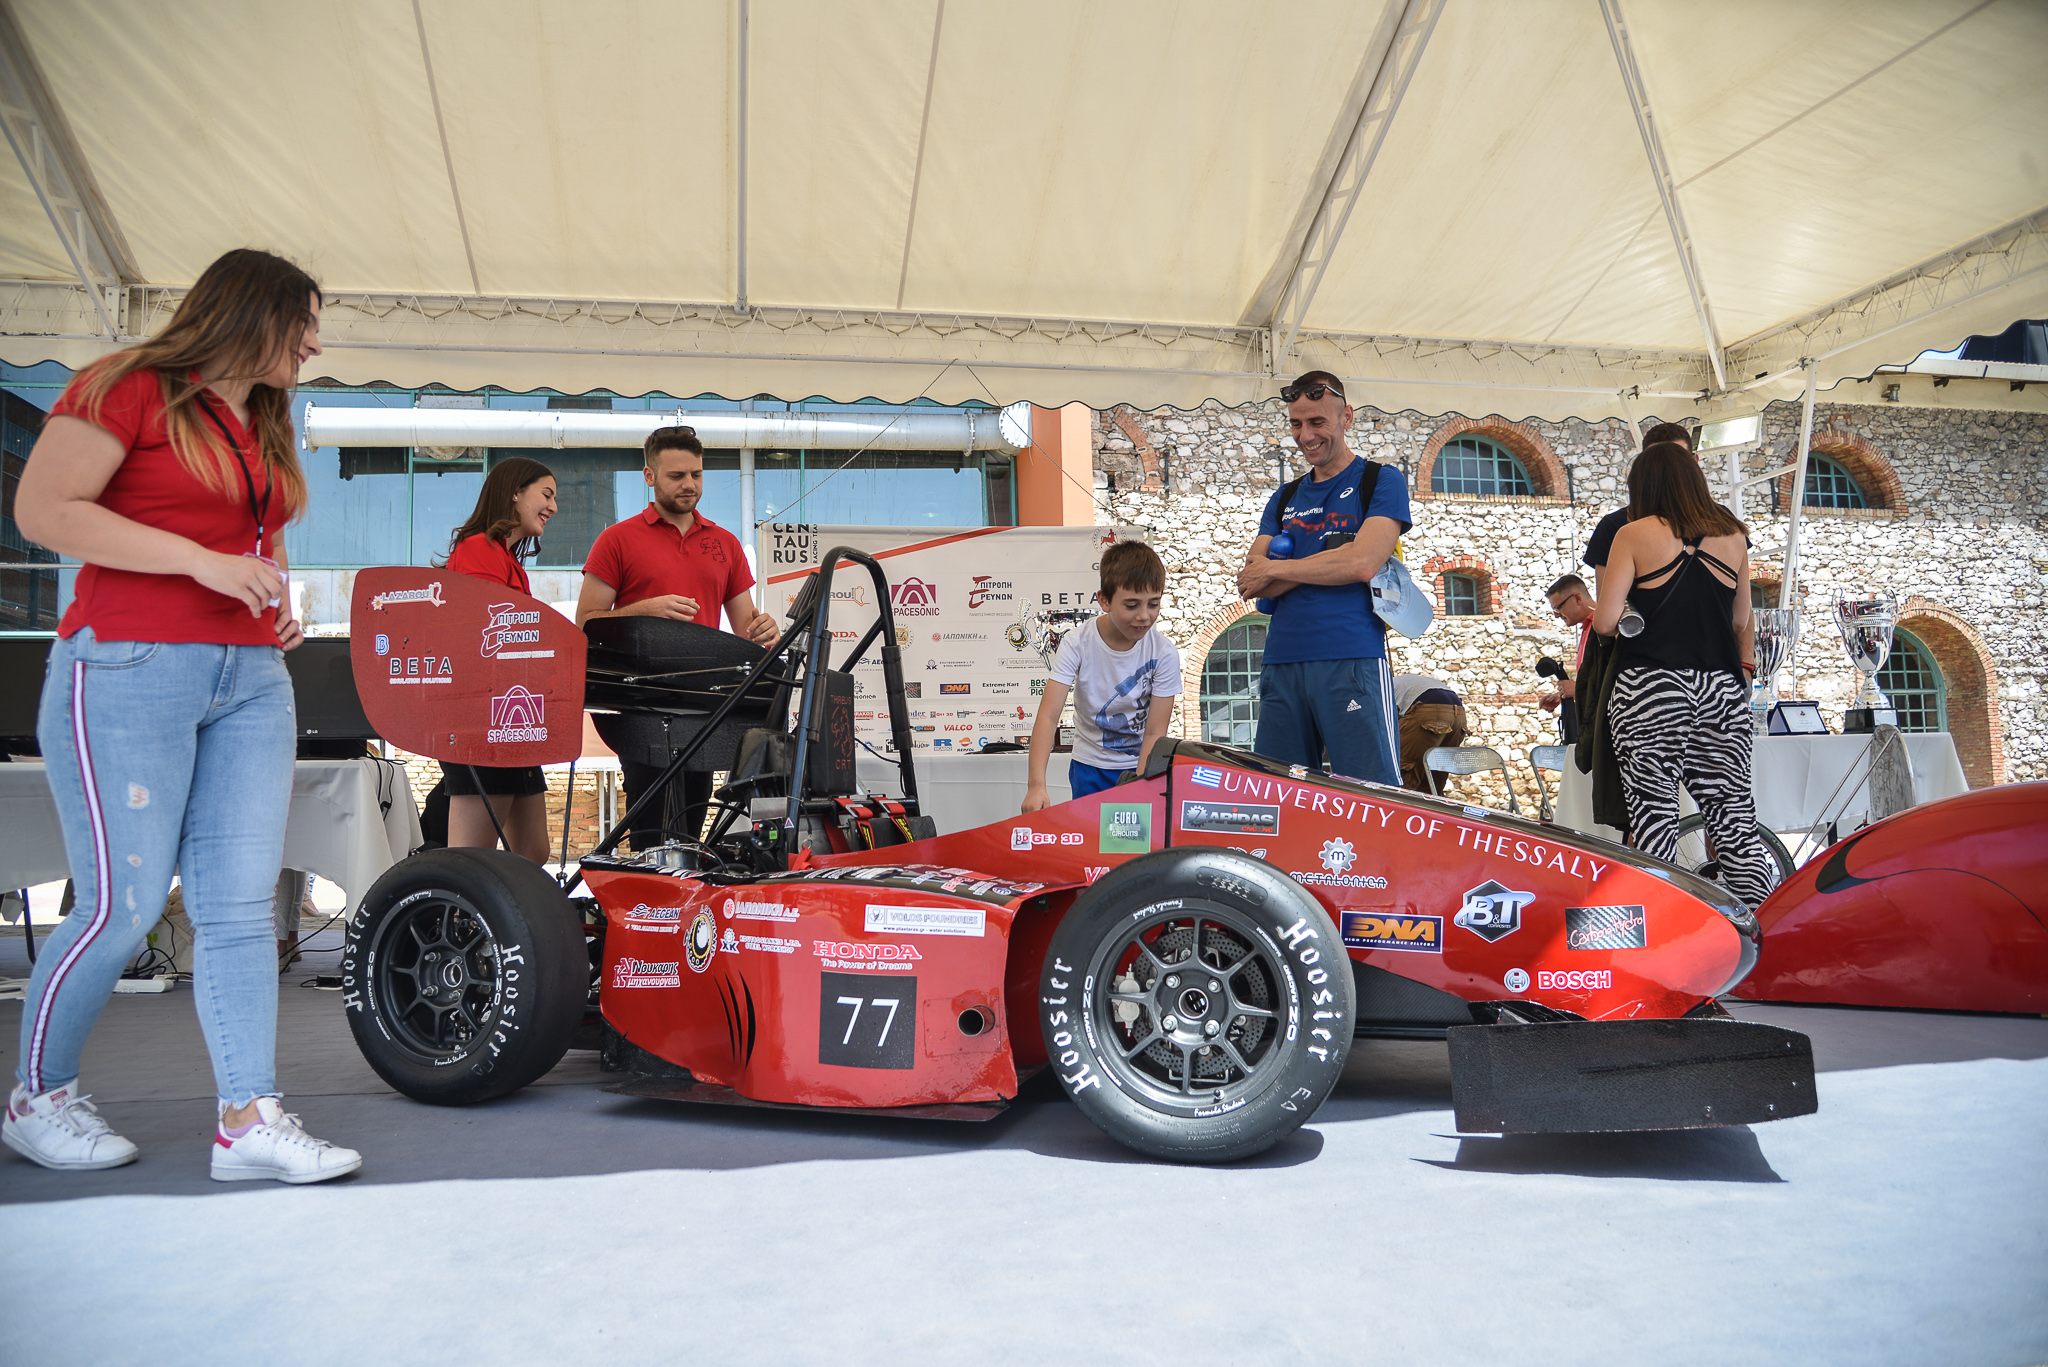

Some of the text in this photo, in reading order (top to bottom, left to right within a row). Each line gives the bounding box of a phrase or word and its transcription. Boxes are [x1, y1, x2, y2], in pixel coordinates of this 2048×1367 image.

[774, 535, 810, 548] TAU
[773, 550, 809, 563] RUS
[892, 607, 940, 617] PACESONIC
[390, 657, 453, 674] BETA
[944, 684, 969, 692] DNA
[488, 727, 547, 743] SPACESONIC
[836, 759, 851, 770] CRT
[1114, 811, 1137, 824] EURO
[1223, 772, 1608, 883] UNIVERSITY OF THESSALY
[1060, 833, 1083, 845] 3D
[648, 907, 681, 920] AEGEAN
[735, 901, 784, 916] ΙΑΠΩΝΙΚΗ
[1132, 898, 1183, 920] Formula Student
[890, 912, 979, 925] VOLOS FOUNDRIES
[1347, 917, 1435, 942] DNA
[762, 944, 794, 954] WORKSHOP
[813, 941, 922, 960] HONDA
[1362, 938, 1407, 946] PERFORMANCE
[492, 944, 502, 974] RACING
[821, 958, 913, 970] The Power of Dreams
[1283, 964, 1298, 1004] RACING
[1538, 970, 1611, 989] BOSCH
[367, 980, 376, 1010] RACING
[1276, 918, 1342, 1062] Hoosier
[489, 944, 525, 1057] Hoosier
[837, 996, 900, 1047] 77
[1042, 957, 1101, 1095] Hoosier
[1083, 1012, 1097, 1049] RACING
[1194, 1106, 1222, 1117] Formula
[1221, 1097, 1246, 1114] Student
